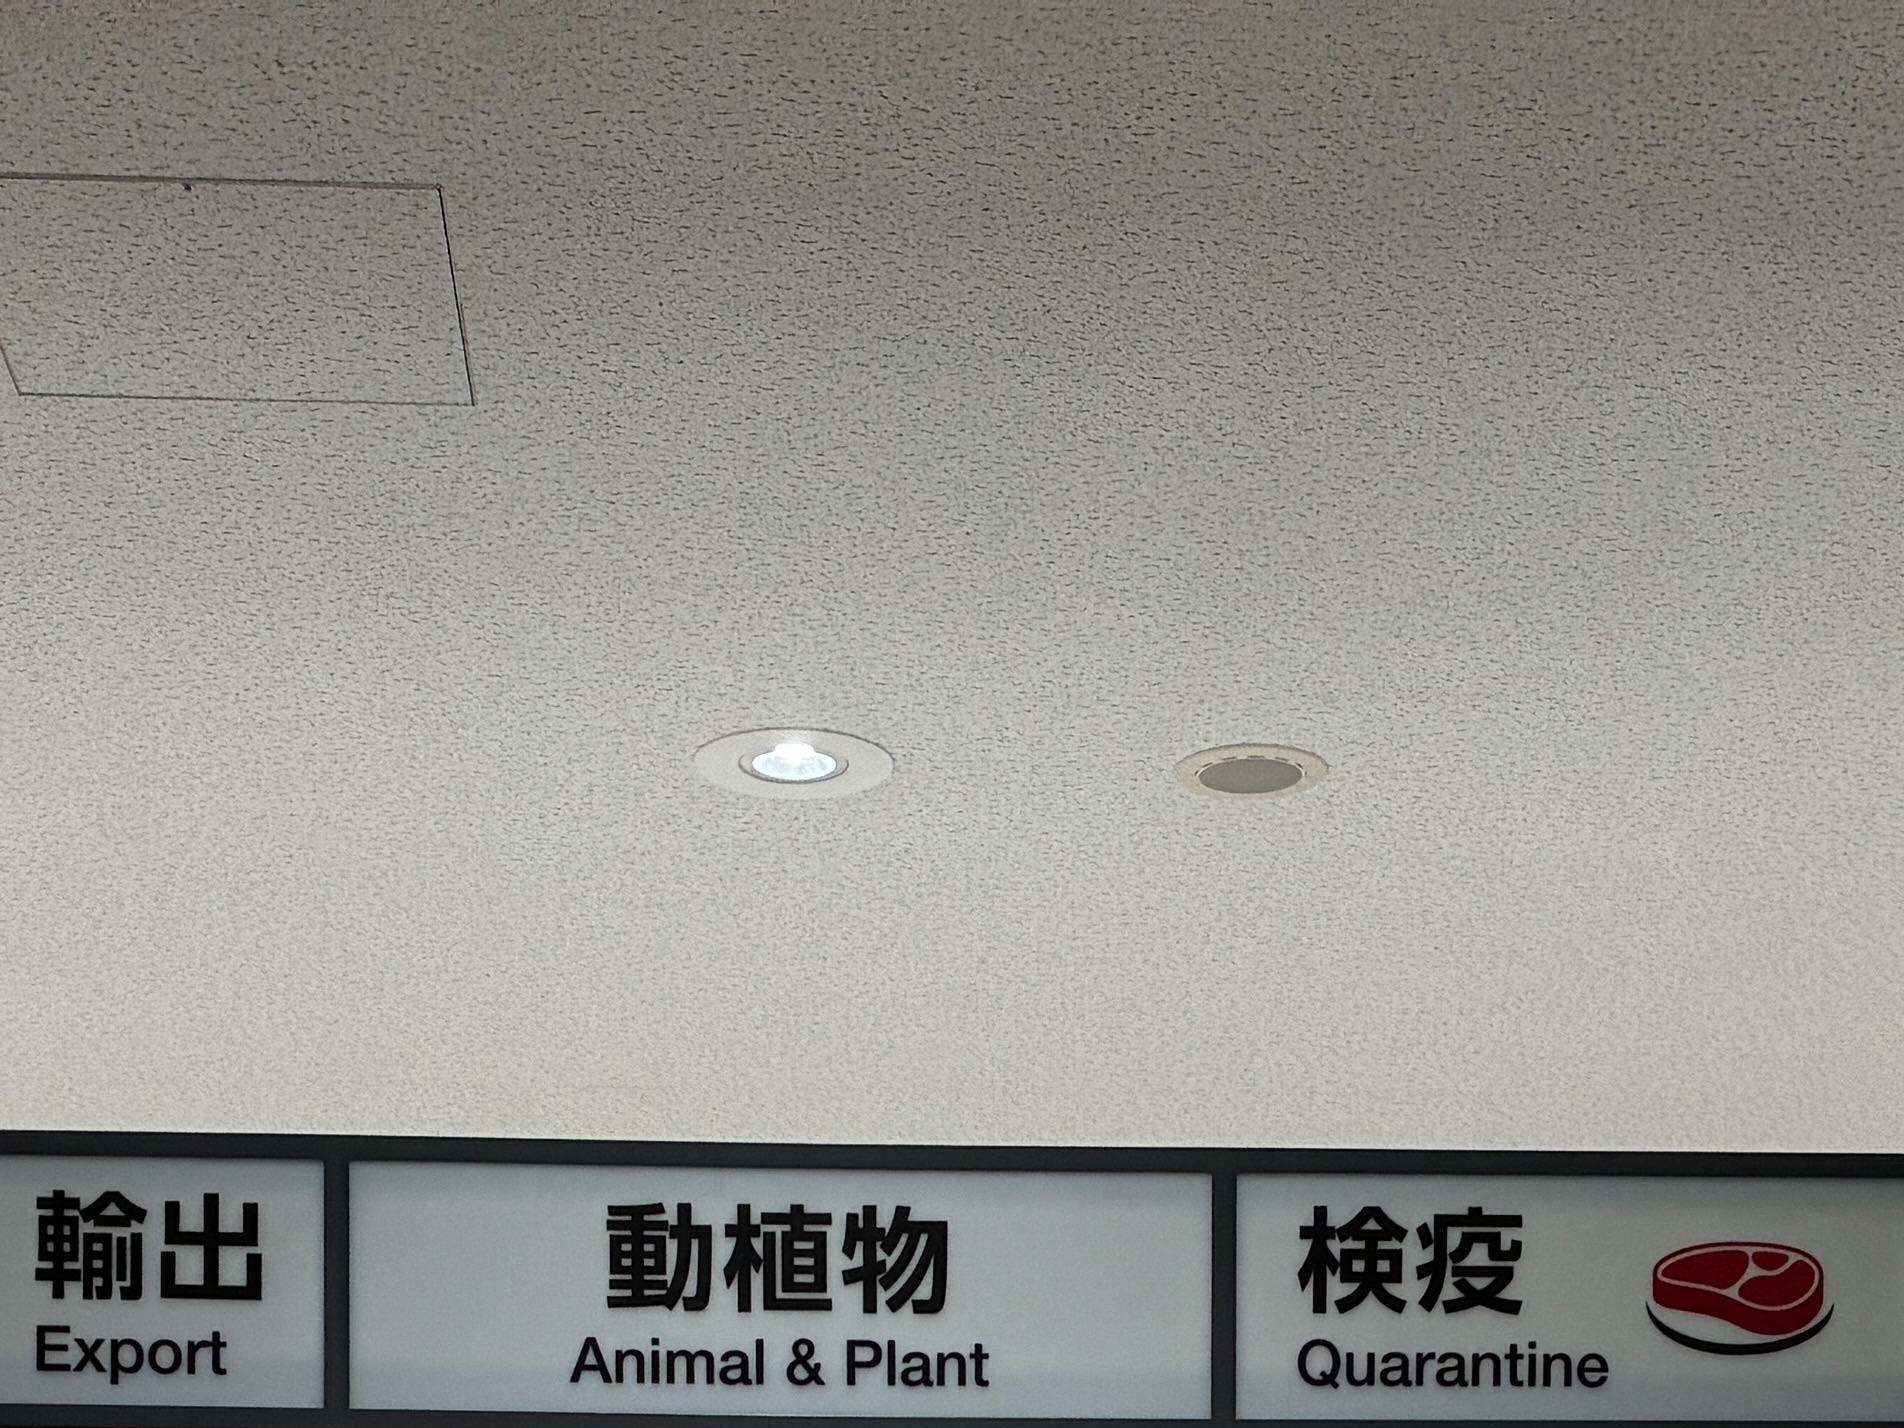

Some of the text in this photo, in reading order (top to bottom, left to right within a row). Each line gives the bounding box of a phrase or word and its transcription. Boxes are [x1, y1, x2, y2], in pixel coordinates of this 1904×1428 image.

[35, 1188, 263, 1302] 輸出
[606, 1202, 949, 1315] 動植物
[1298, 1205, 1524, 1316] 検疫
[36, 1325, 227, 1385] Export
[569, 1337, 990, 1388] Animal & Plant
[1298, 1339, 1609, 1391] Quarantine
